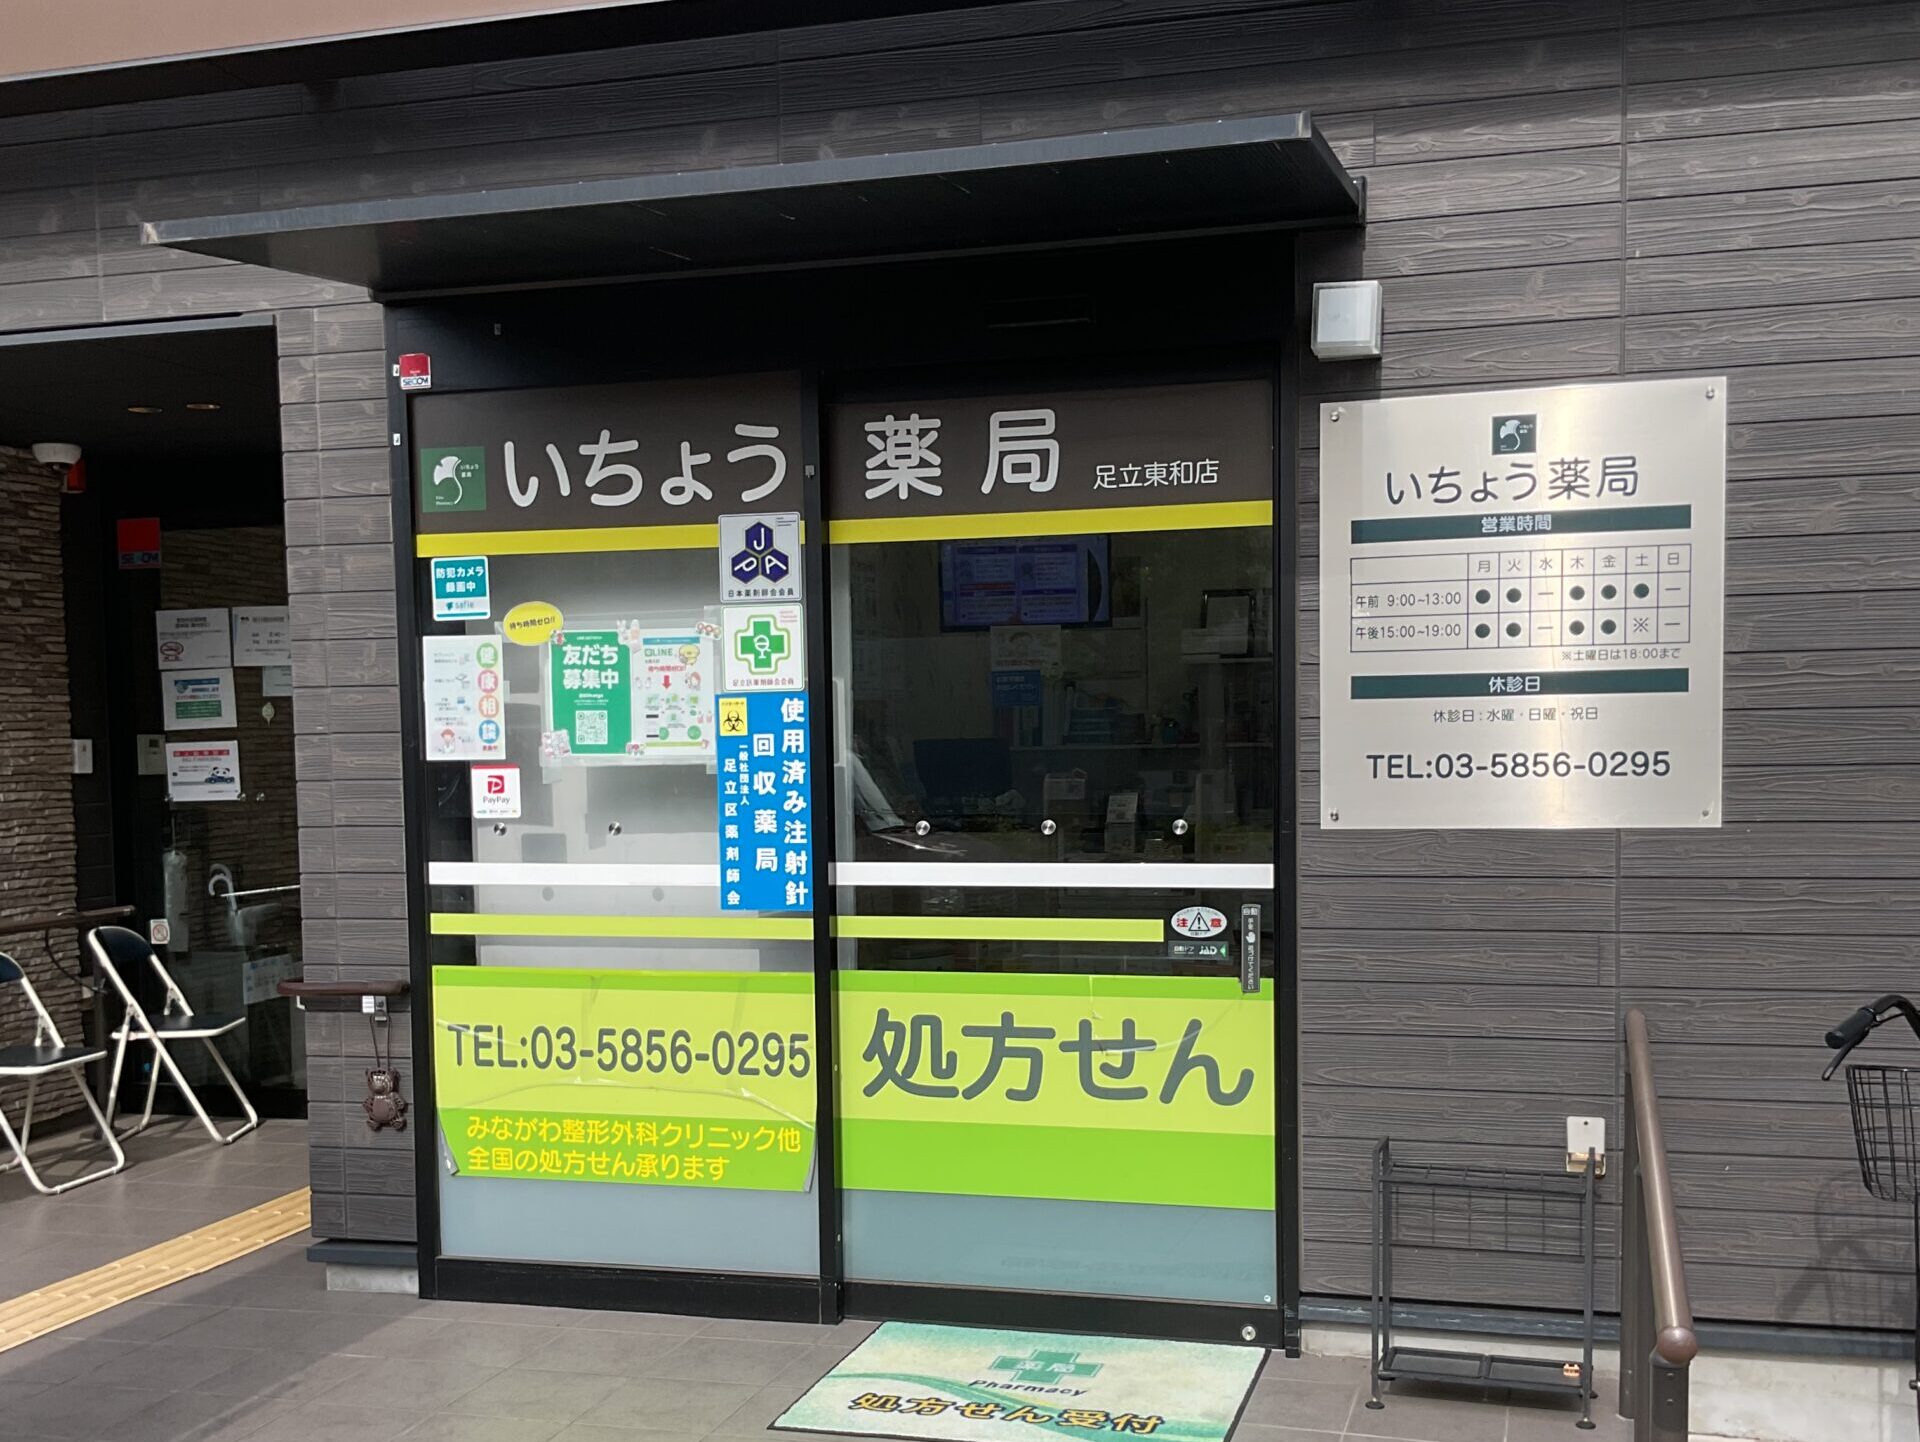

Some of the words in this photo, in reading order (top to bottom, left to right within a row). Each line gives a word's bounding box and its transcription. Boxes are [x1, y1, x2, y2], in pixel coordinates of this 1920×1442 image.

[503, 423, 787, 508] いちょう
[864, 408, 1060, 500] 薬局
[1093, 458, 1220, 490] 足立東和店
[1385, 455, 1640, 505] いちょう薬局
[1480, 513, 1553, 533] 営業時間
[436, 566, 485, 579] 防犯カメラ
[1477, 561, 1491, 573] 月
[1507, 559, 1521, 571] 火
[1539, 557, 1553, 570] 水
[1570, 556, 1584, 569] 木
[1601, 554, 1617, 568] 金
[1635, 554, 1649, 567] 土
[1667, 552, 1680, 565] 日
[1356, 595, 1379, 609] 午前
[562, 644, 619, 666] 友だち
[563, 668, 619, 690] 募集中
[1488, 676, 1541, 693] 休診日
[739, 743, 750, 806] 一般社団法人
[1366, 751, 1671, 779] TEL:03-5856-0295
[482, 796, 511, 805] PayPay
[753, 733, 778, 872] 回収薬局
[780, 697, 809, 906] 使用済み注射針
[723, 758, 741, 905] 足立区薬剤師会
[447, 1024, 812, 1078] TEL:03-5856-0295
[862, 1008, 1255, 1106] 処方せん
[466, 1115, 802, 1154] みながわ整形外科クリニック他
[466, 1146, 730, 1180] 全国の処方せん承ります
[1012, 1360, 1076, 1374] 薬局
[967, 1378, 1088, 1397] Pharmacy
[848, 1391, 1166, 1435] 処方せん受付
